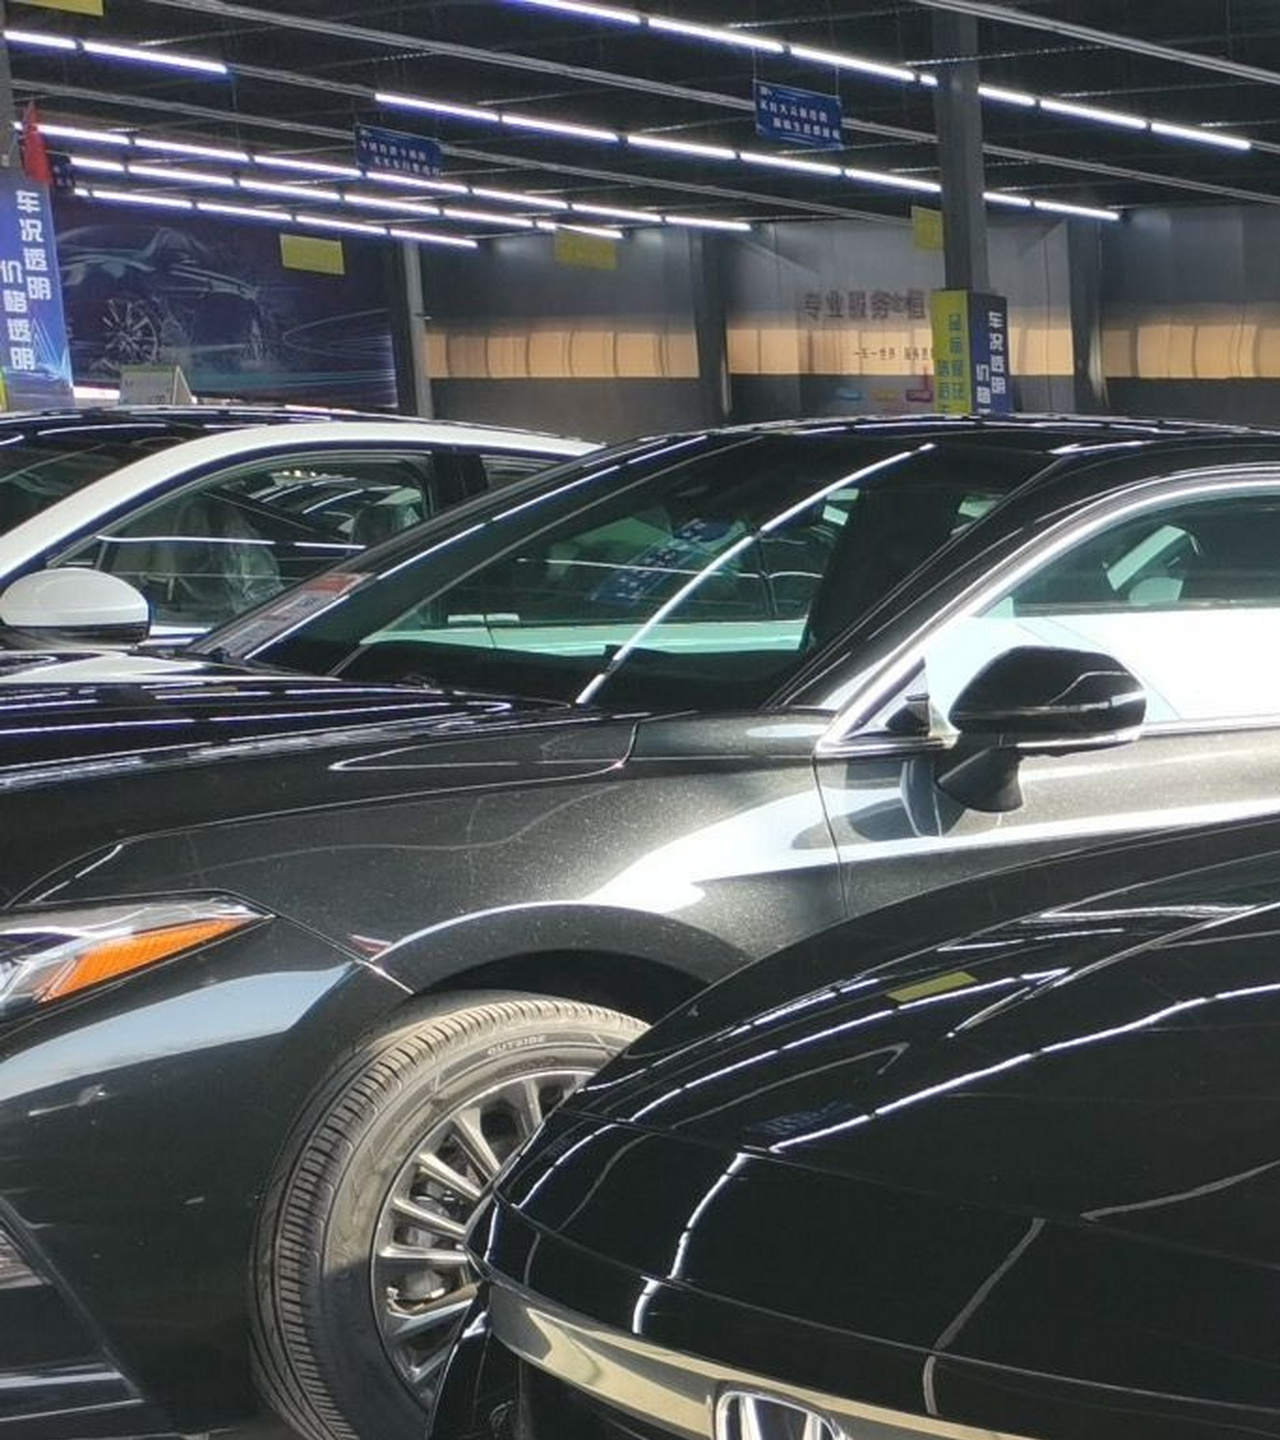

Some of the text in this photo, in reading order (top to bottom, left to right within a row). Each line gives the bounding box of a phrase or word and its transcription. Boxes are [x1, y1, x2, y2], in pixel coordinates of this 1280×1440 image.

[15, 189, 52, 301] 车况透明
[0, 259, 36, 371] 价格透明
